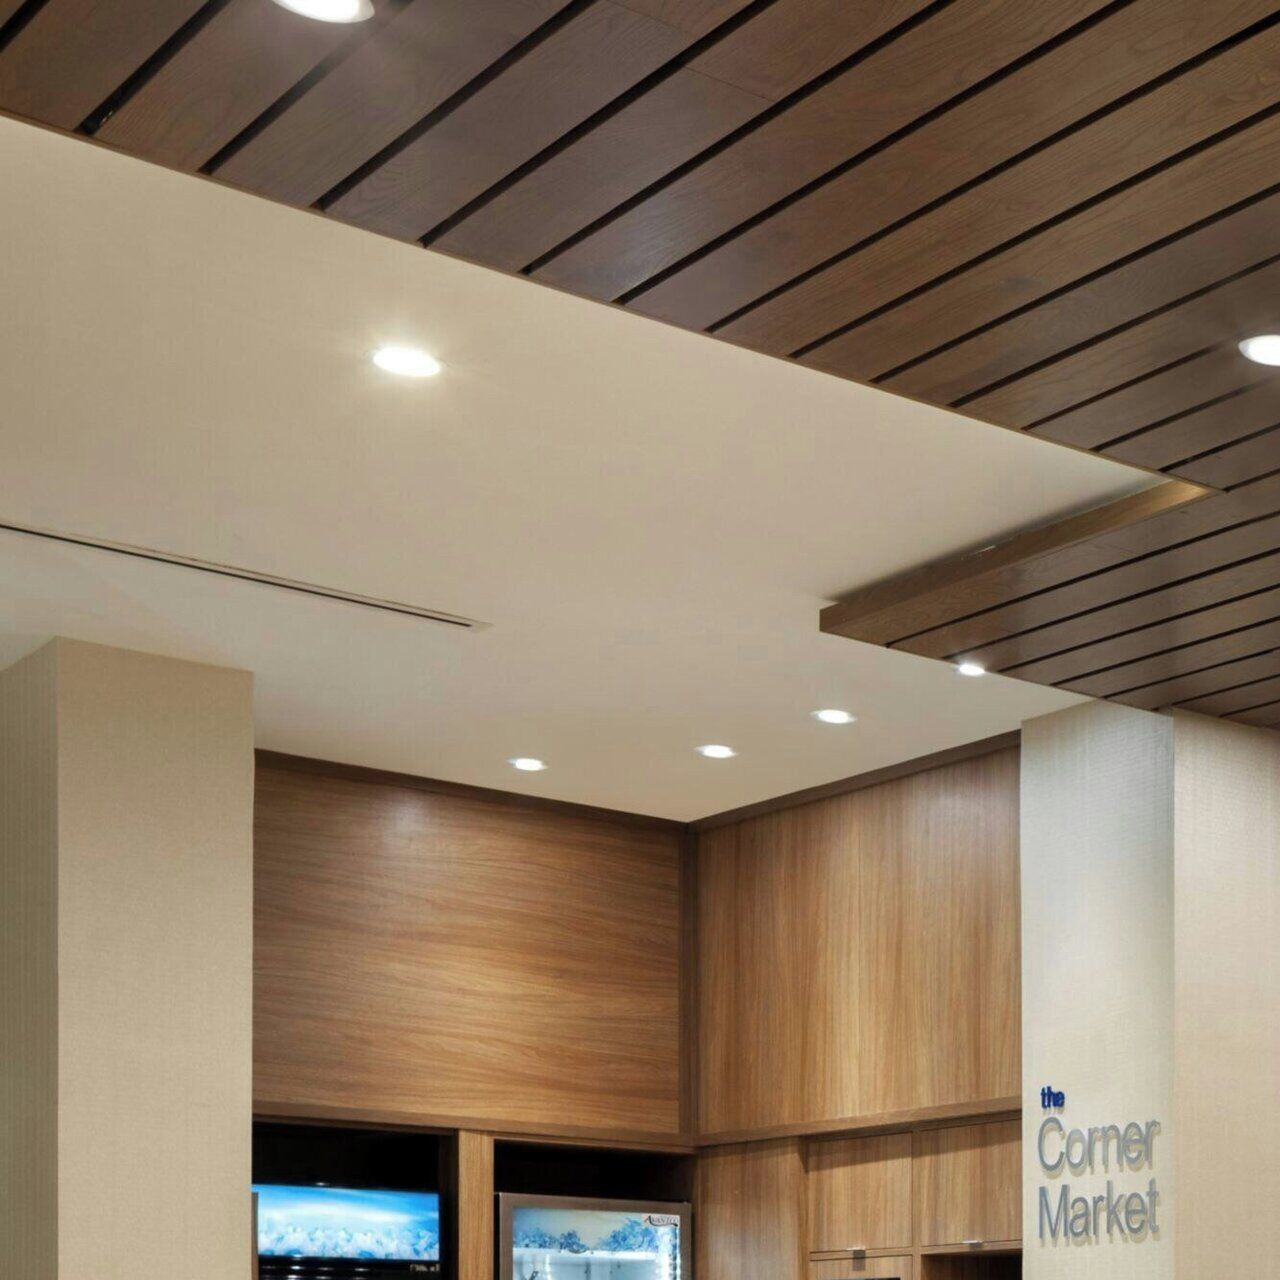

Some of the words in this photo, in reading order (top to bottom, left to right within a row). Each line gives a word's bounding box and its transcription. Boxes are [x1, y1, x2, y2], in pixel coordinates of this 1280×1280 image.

[1041, 1086, 1065, 1109] the
[1038, 1116, 1161, 1172] Corner
[1038, 1178, 1159, 1239] Market
